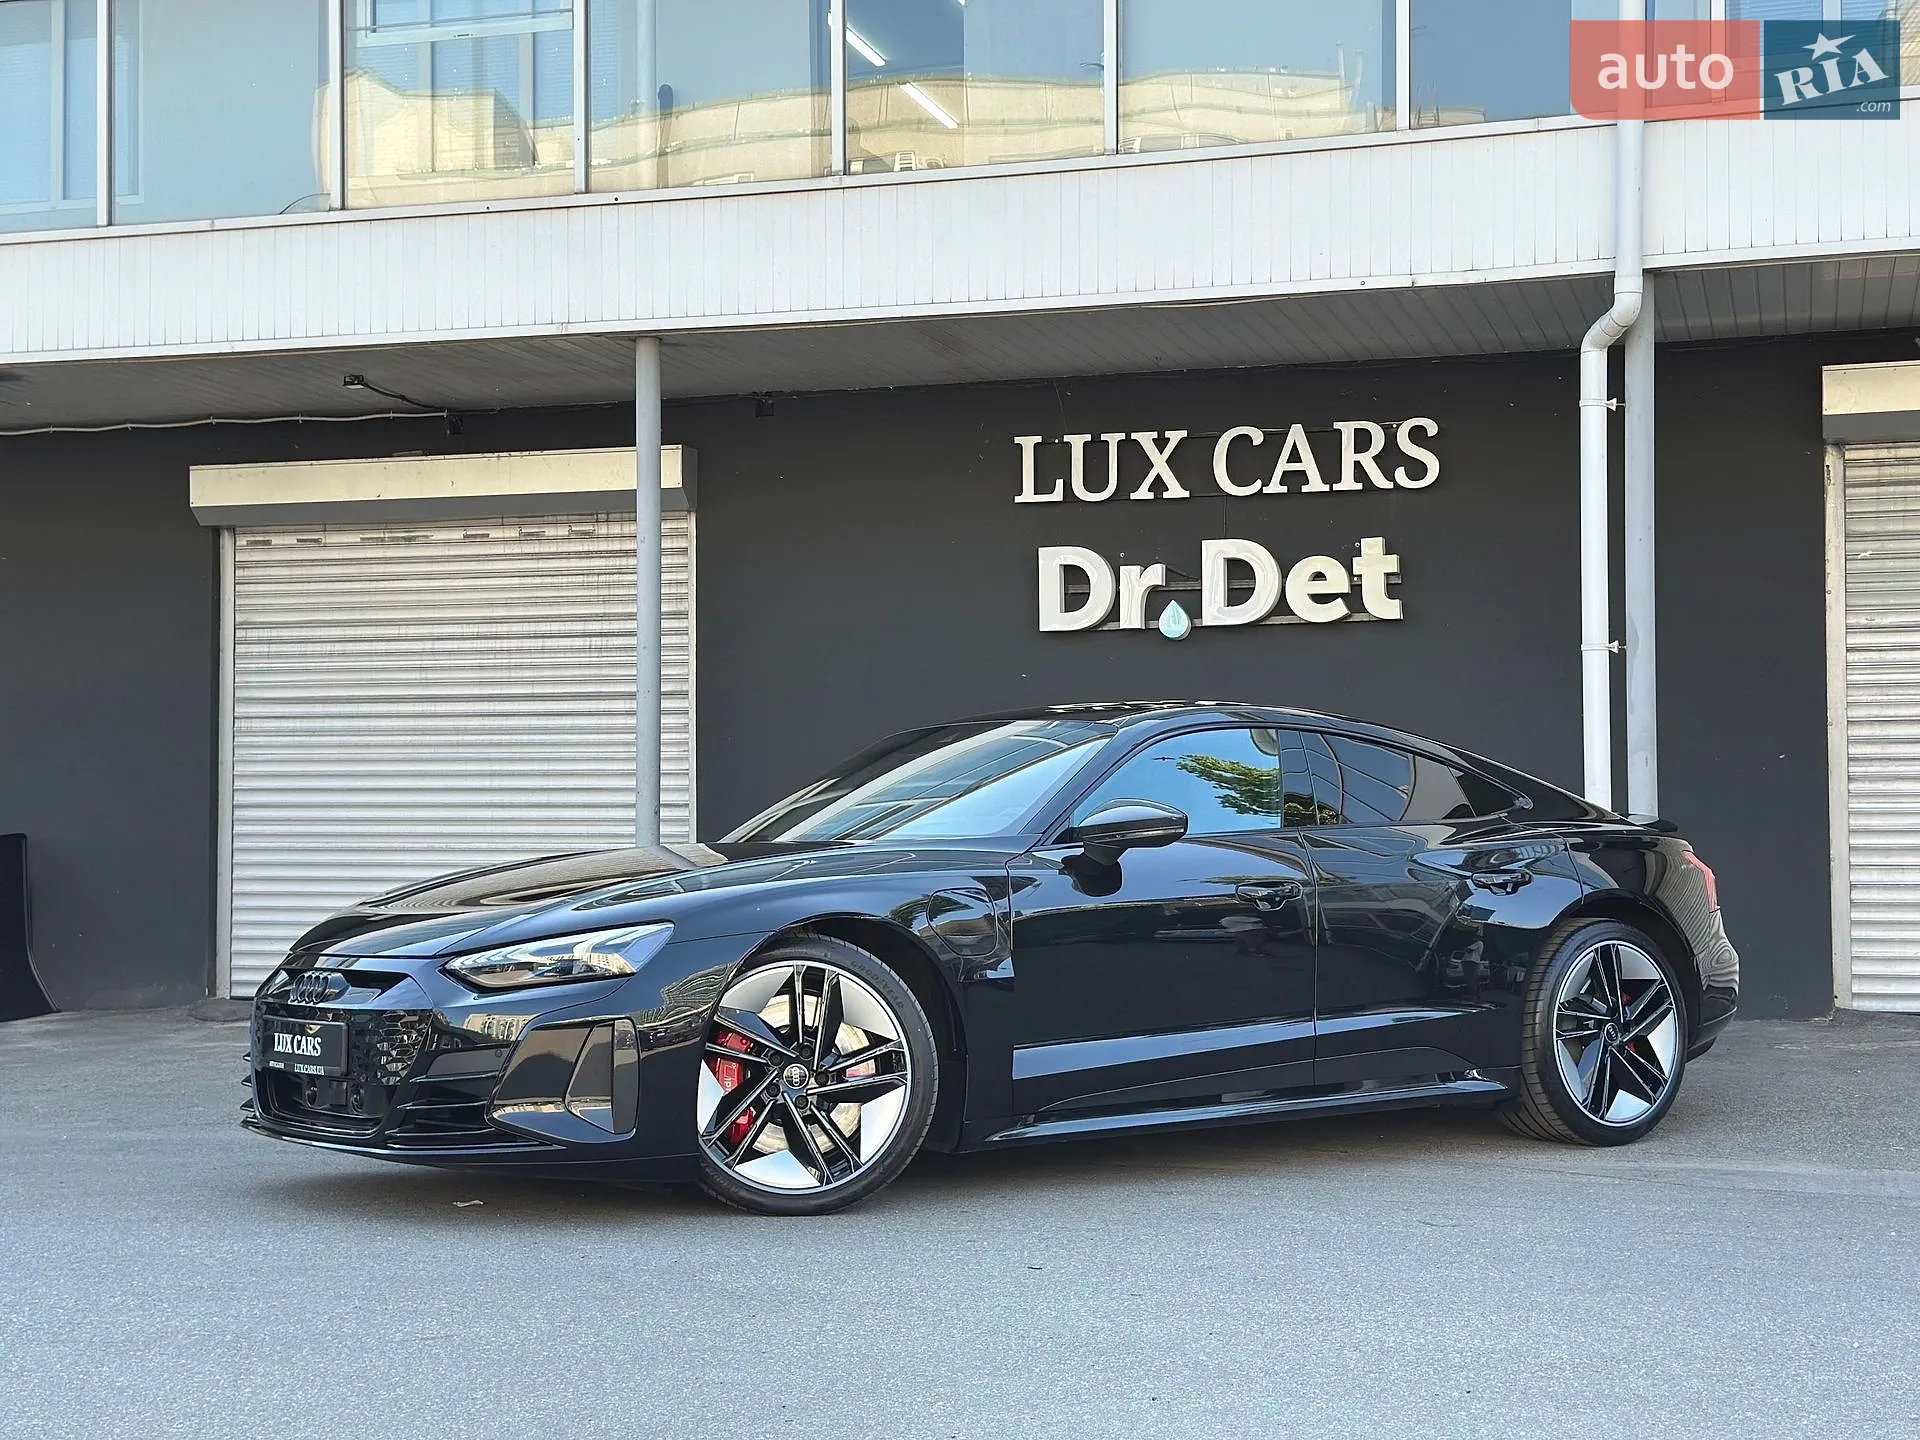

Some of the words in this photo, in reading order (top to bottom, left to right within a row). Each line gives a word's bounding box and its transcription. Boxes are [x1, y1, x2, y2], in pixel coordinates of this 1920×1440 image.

[1013, 429, 1191, 503] LUX
[1212, 417, 1441, 497] CARS
[274, 1033, 293, 1053] LUX
[294, 1035, 321, 1056] CARS
